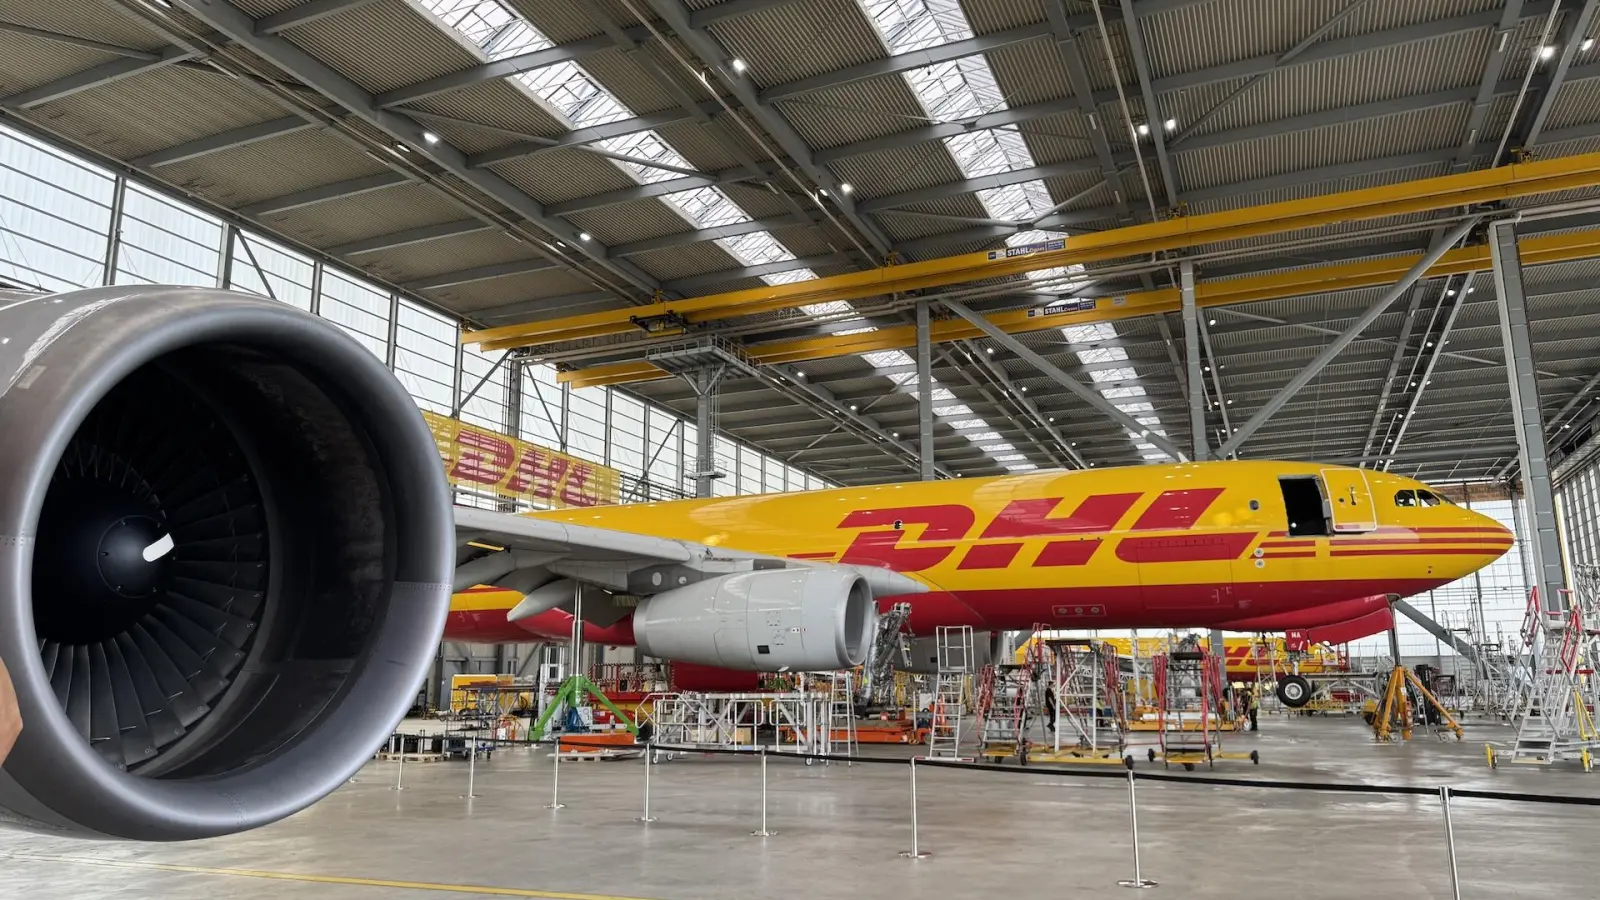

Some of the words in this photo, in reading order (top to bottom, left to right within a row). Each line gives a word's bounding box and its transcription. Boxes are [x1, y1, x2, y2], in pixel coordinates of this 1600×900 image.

[1007, 246, 1029, 257] STAHL
[1044, 306, 1065, 315] STAHL
[450, 430, 599, 507] DHL
[836, 487, 1259, 573] DHL
